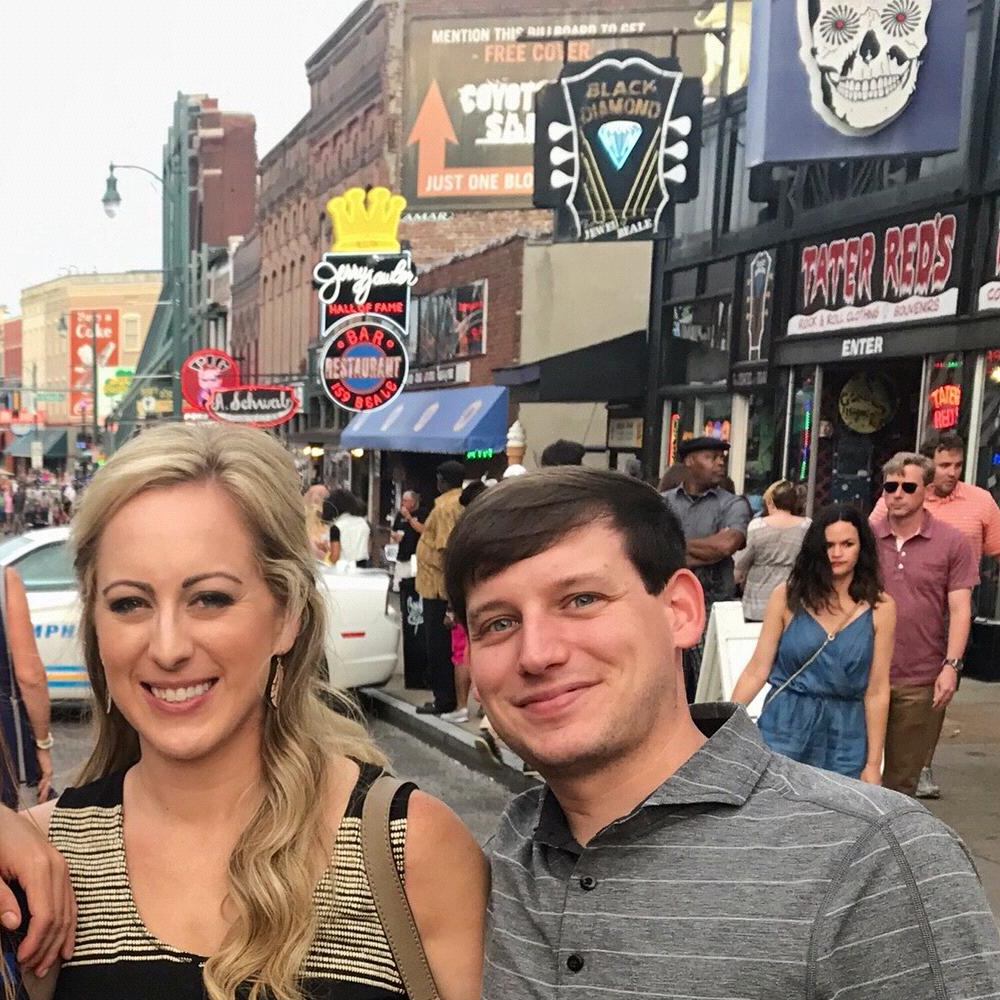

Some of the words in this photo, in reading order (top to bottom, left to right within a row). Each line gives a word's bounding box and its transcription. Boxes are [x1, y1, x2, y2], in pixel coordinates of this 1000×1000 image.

[432, 28, 490, 44] MENTION
[494, 26, 525, 42] THIS
[601, 23, 617, 35] TO
[621, 22, 646, 34] GET
[484, 44, 526, 62] FREE
[458, 79, 544, 113] COYOT
[586, 79, 657, 98] BLACK
[580, 97, 662, 123] DIAMOND
[425, 174, 465, 192] JUST
[468, 173, 500, 190] ONE
[401, 211, 450, 223] AMAR
[616, 218, 653, 240] BEALE
[801, 231, 875, 309] TATER
[883, 211, 957, 298] RED'S
[328, 303, 356, 314] HALL
[358, 302, 373, 313] OF
[375, 302, 403, 313] FAME
[345, 326, 384, 346] BAR
[841, 336, 884, 357] ENTER
[325, 355, 402, 379] RESTAURANT
[230, 390, 290, 411] Schwab
[330, 382, 351, 403] 159
[354, 380, 397, 409] BEALE
